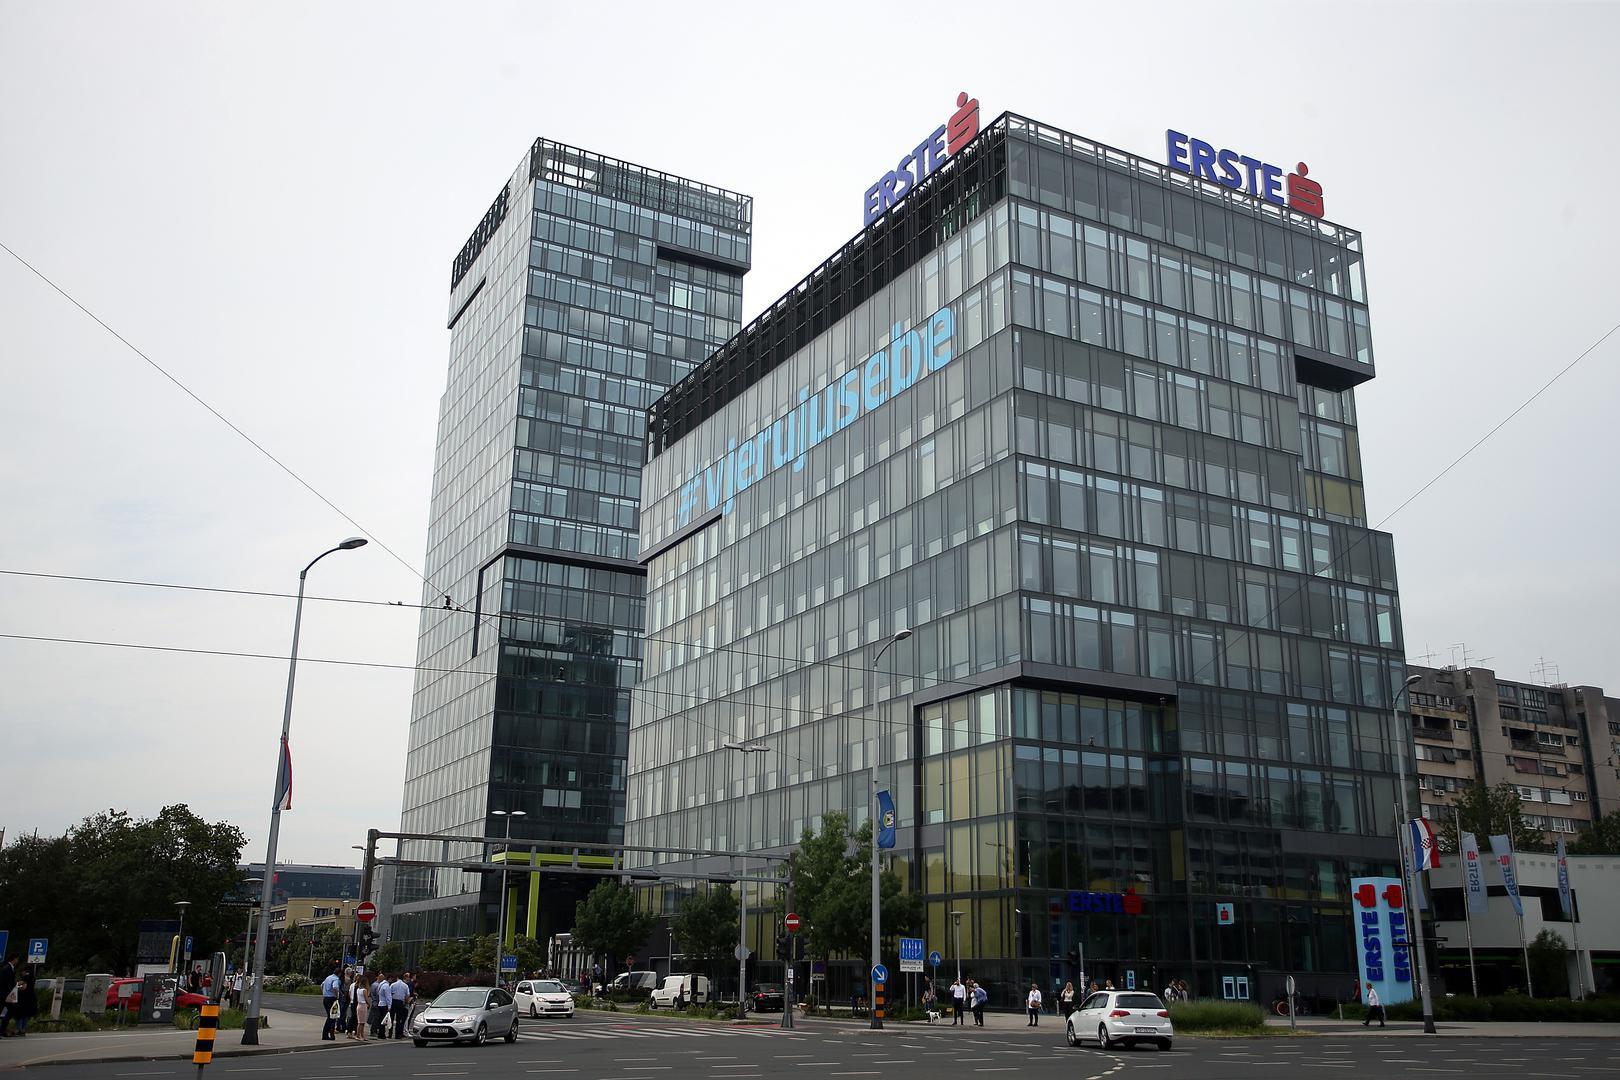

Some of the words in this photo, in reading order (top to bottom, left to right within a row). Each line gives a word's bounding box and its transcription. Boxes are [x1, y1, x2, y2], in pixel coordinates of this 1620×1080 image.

[864, 124, 947, 227] ERSTE
[1167, 129, 1285, 205] ERSTE
[679, 307, 956, 529] #vjerujusebe
[1069, 891, 1125, 914] ERSTE
[1361, 911, 1384, 981] ERSTE
[1389, 911, 1411, 982] ERSTE
